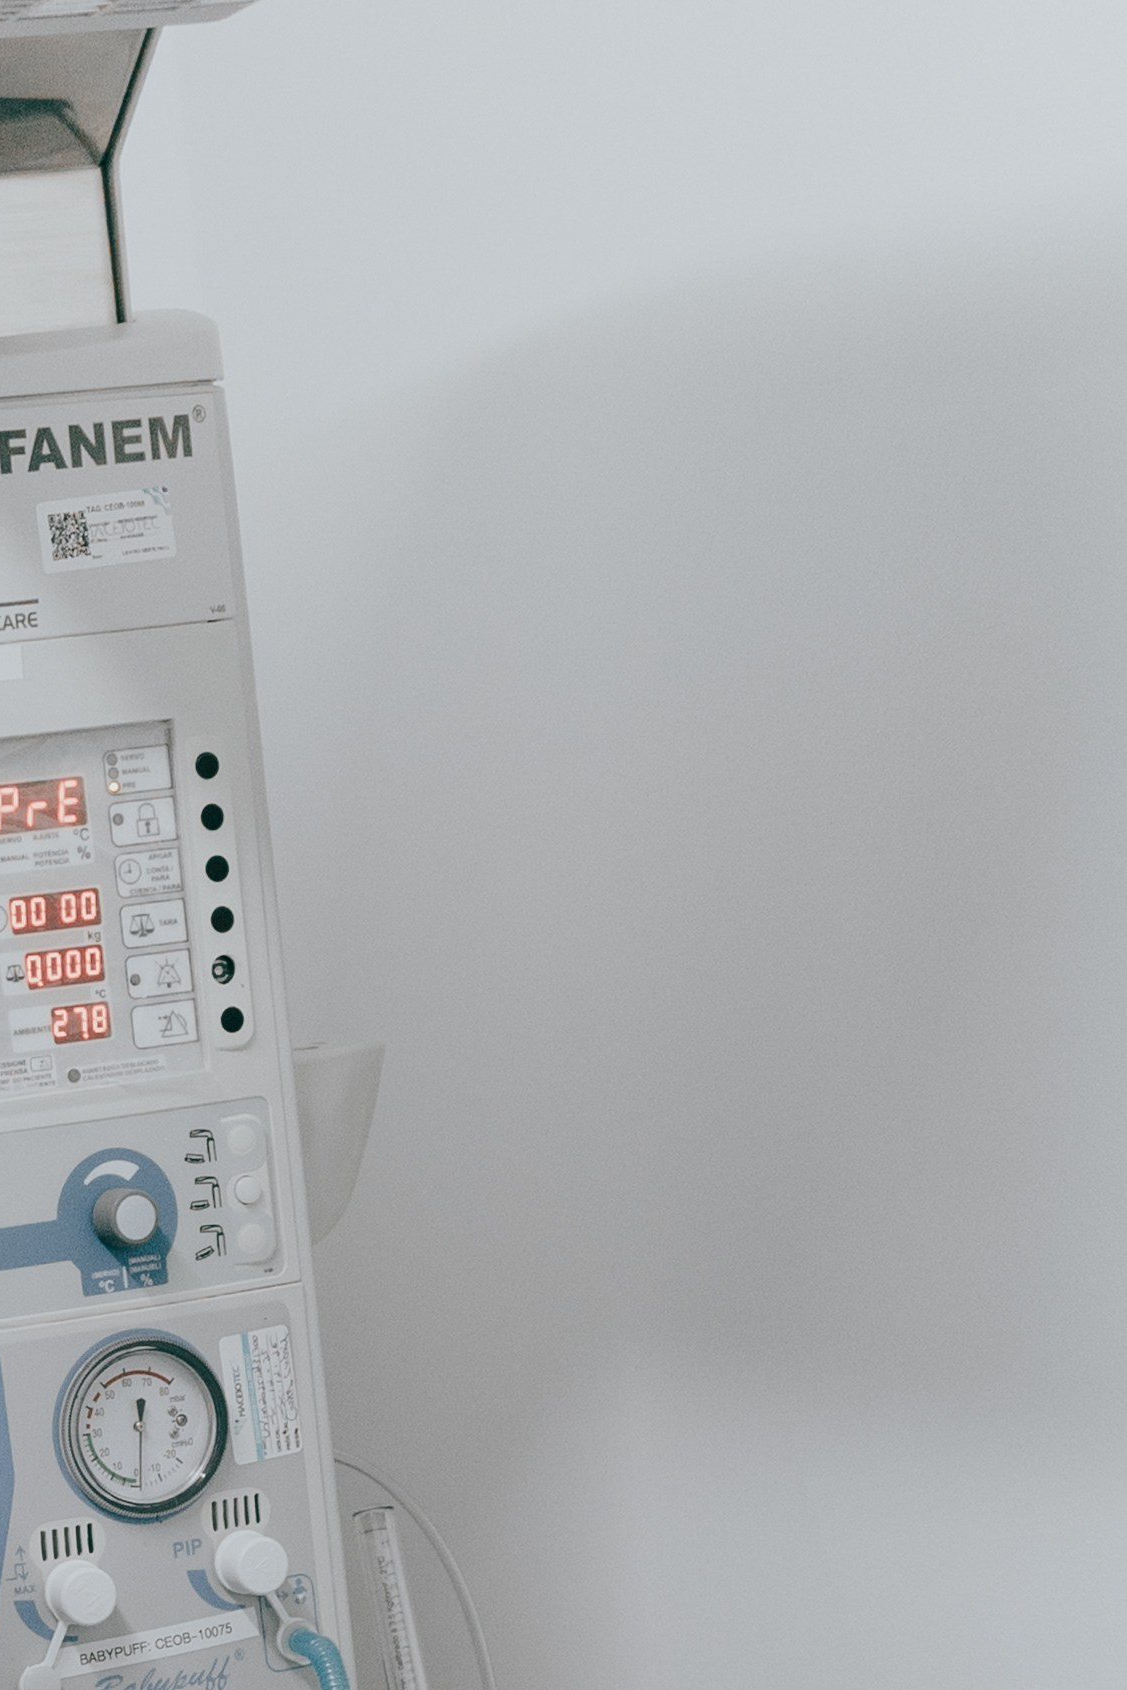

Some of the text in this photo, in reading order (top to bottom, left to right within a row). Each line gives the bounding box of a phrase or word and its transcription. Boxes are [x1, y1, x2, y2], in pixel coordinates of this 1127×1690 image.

[87, 930, 102, 942] kg
[0, 1068, 28, 1077] PRENSA
[105, 1378, 170, 1400] 50 60 70 80
[94, 1408, 105, 1417] 40
[92, 1428, 103, 1438] 30
[100, 1448, 110, 1457] 20
[112, 1462, 123, 1471] 10
[173, 1538, 203, 1559] PIP
[79, 1623, 233, 1666] BABYPUFF: CEOB-10075
